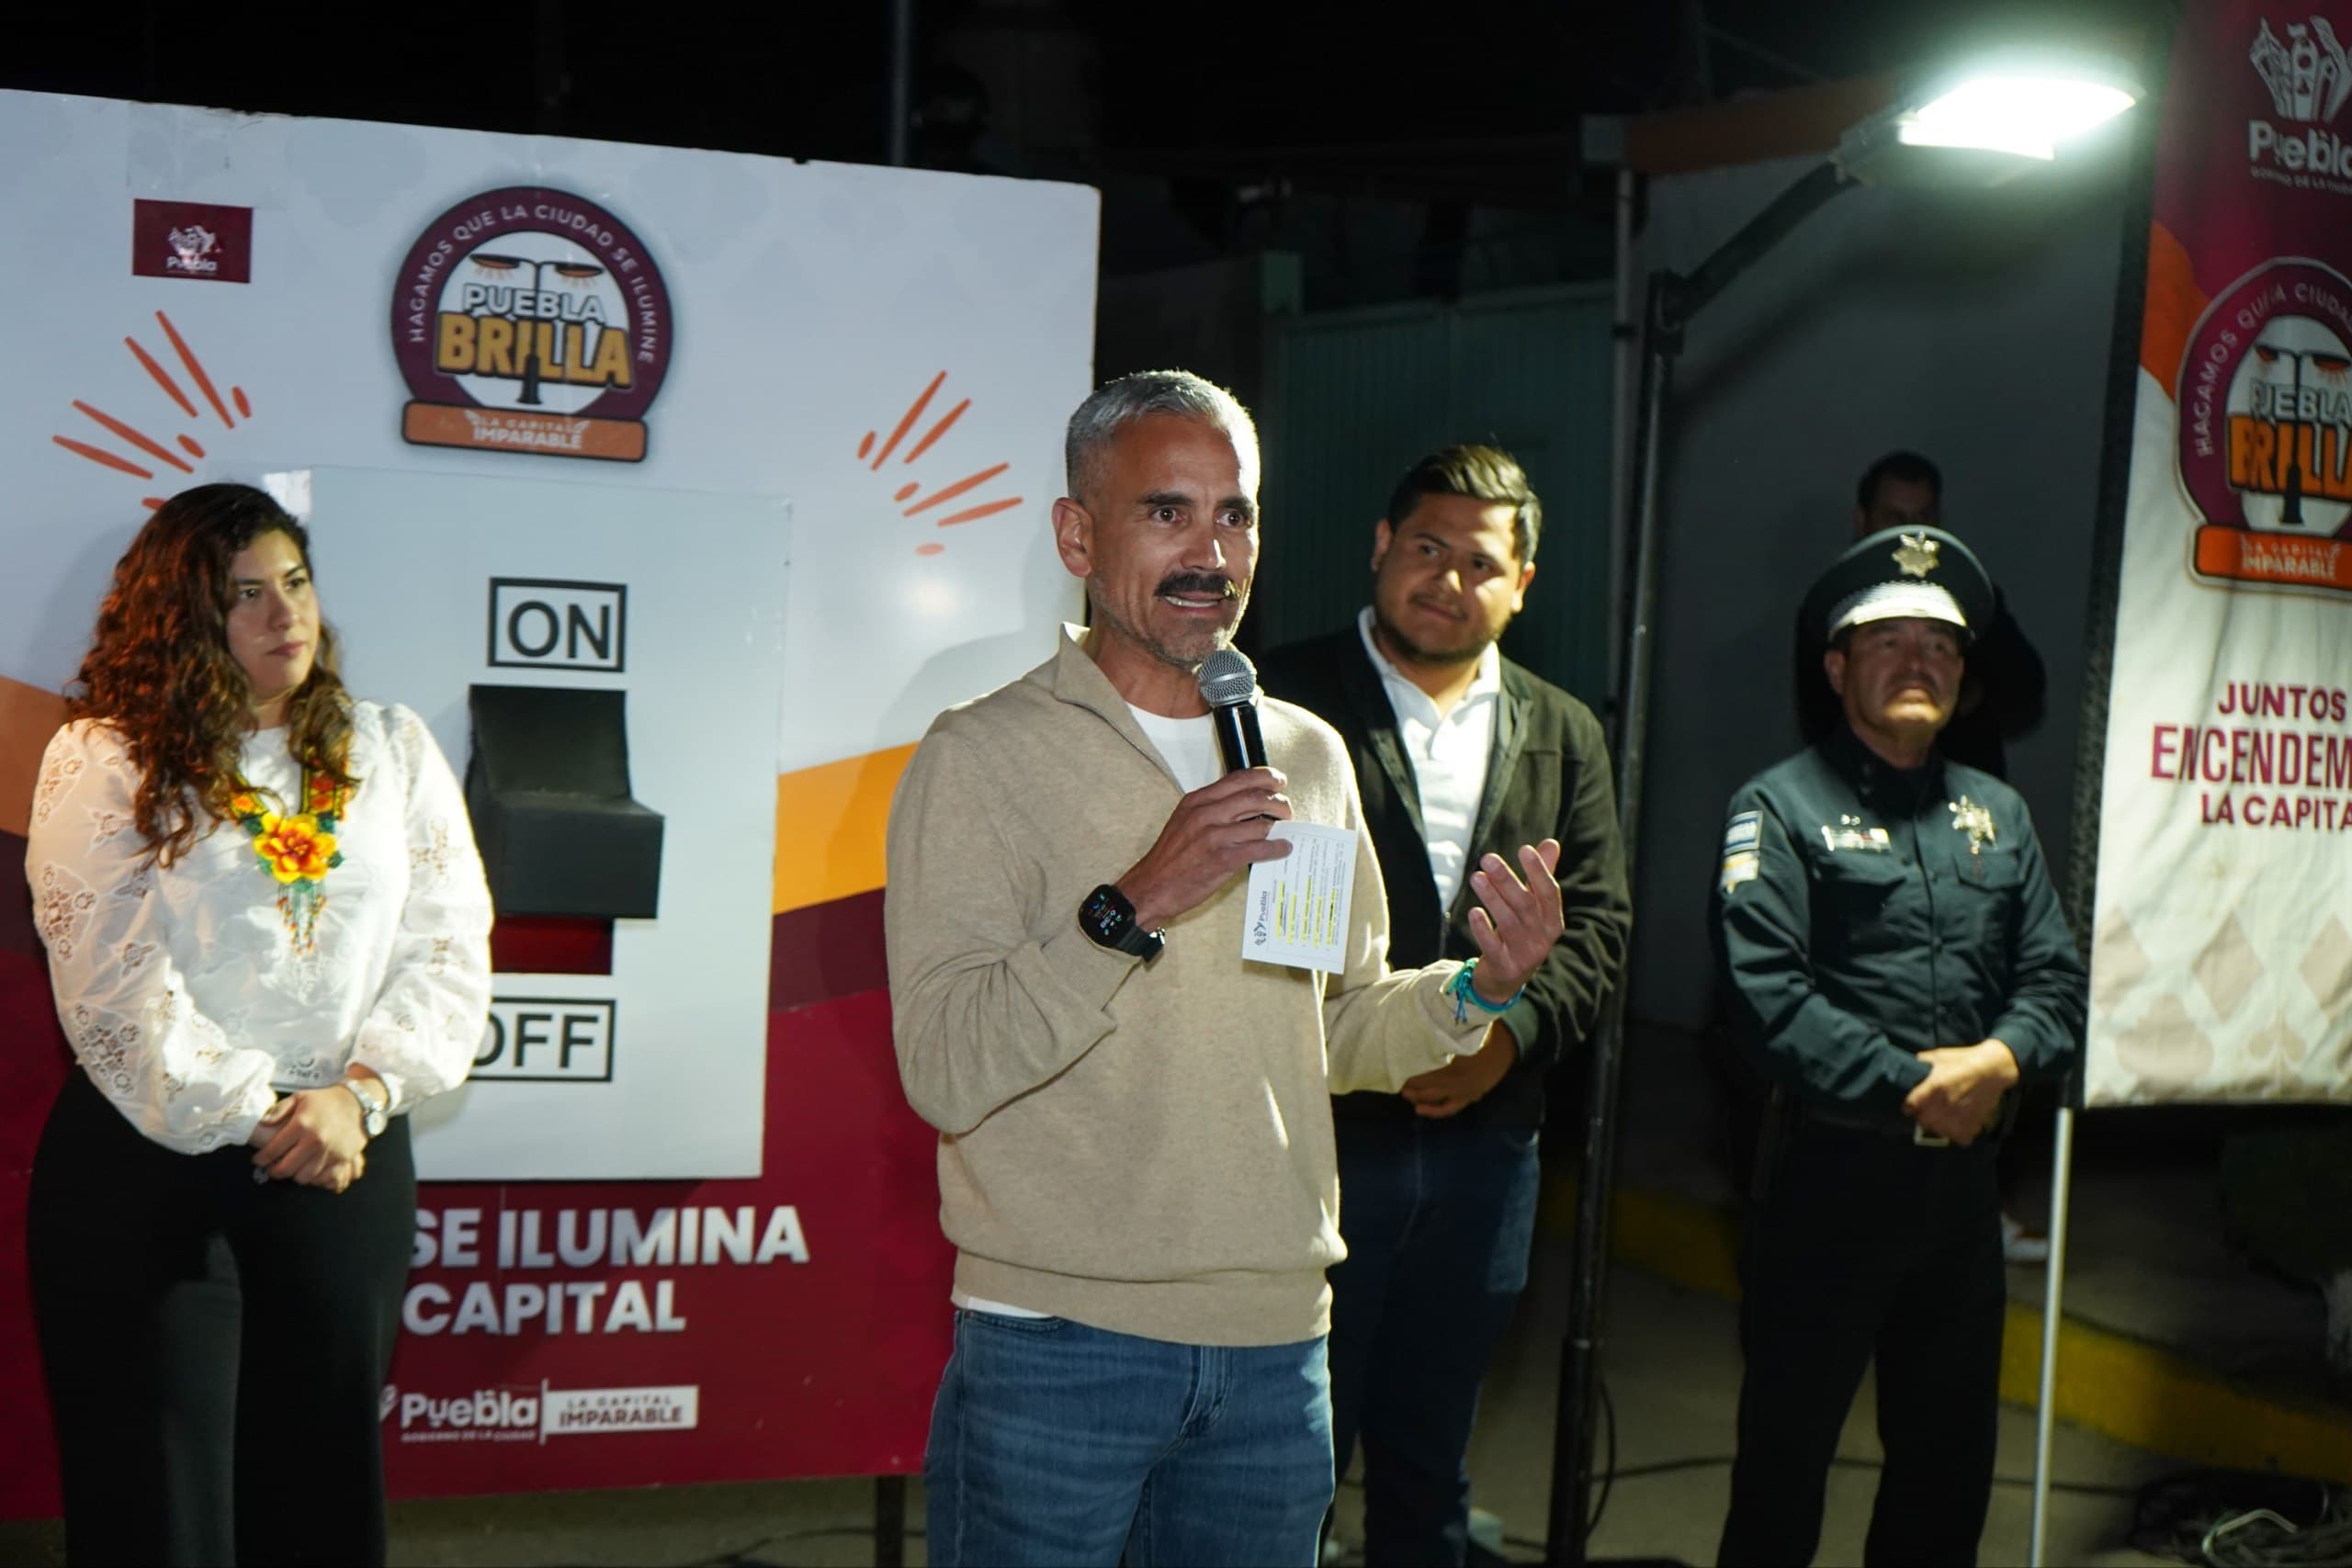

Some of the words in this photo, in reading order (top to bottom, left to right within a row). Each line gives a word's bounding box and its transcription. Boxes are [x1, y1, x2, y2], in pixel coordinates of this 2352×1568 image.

[409, 239, 454, 343] HAGAMOS
[453, 210, 497, 242] QUE
[501, 205, 528, 220] LA
[534, 205, 615, 247] CIUDAD
[611, 247, 639, 274] SE
[630, 276, 657, 364] ILUMINE
[462, 282, 607, 322] PUEBLA
[436, 311, 633, 389] BRILLA
[2193, 329, 2238, 457] HAGAMOS
[473, 425, 582, 449] IMPARABLE
[506, 419, 572, 434] CAPITAL
[507, 600, 611, 659] ON
[2218, 682, 2347, 722] JUNTOS
[2201, 791, 2235, 825] LA
[497, 1206, 810, 1269] ILUMINA
[401, 1280, 687, 1336] CAPITAL
[401, 1389, 539, 1429] Puebla
[559, 1405, 683, 1427] IMPARABLE
[566, 1397, 588, 1409] LA
[597, 1395, 673, 1407] CAPITAL
